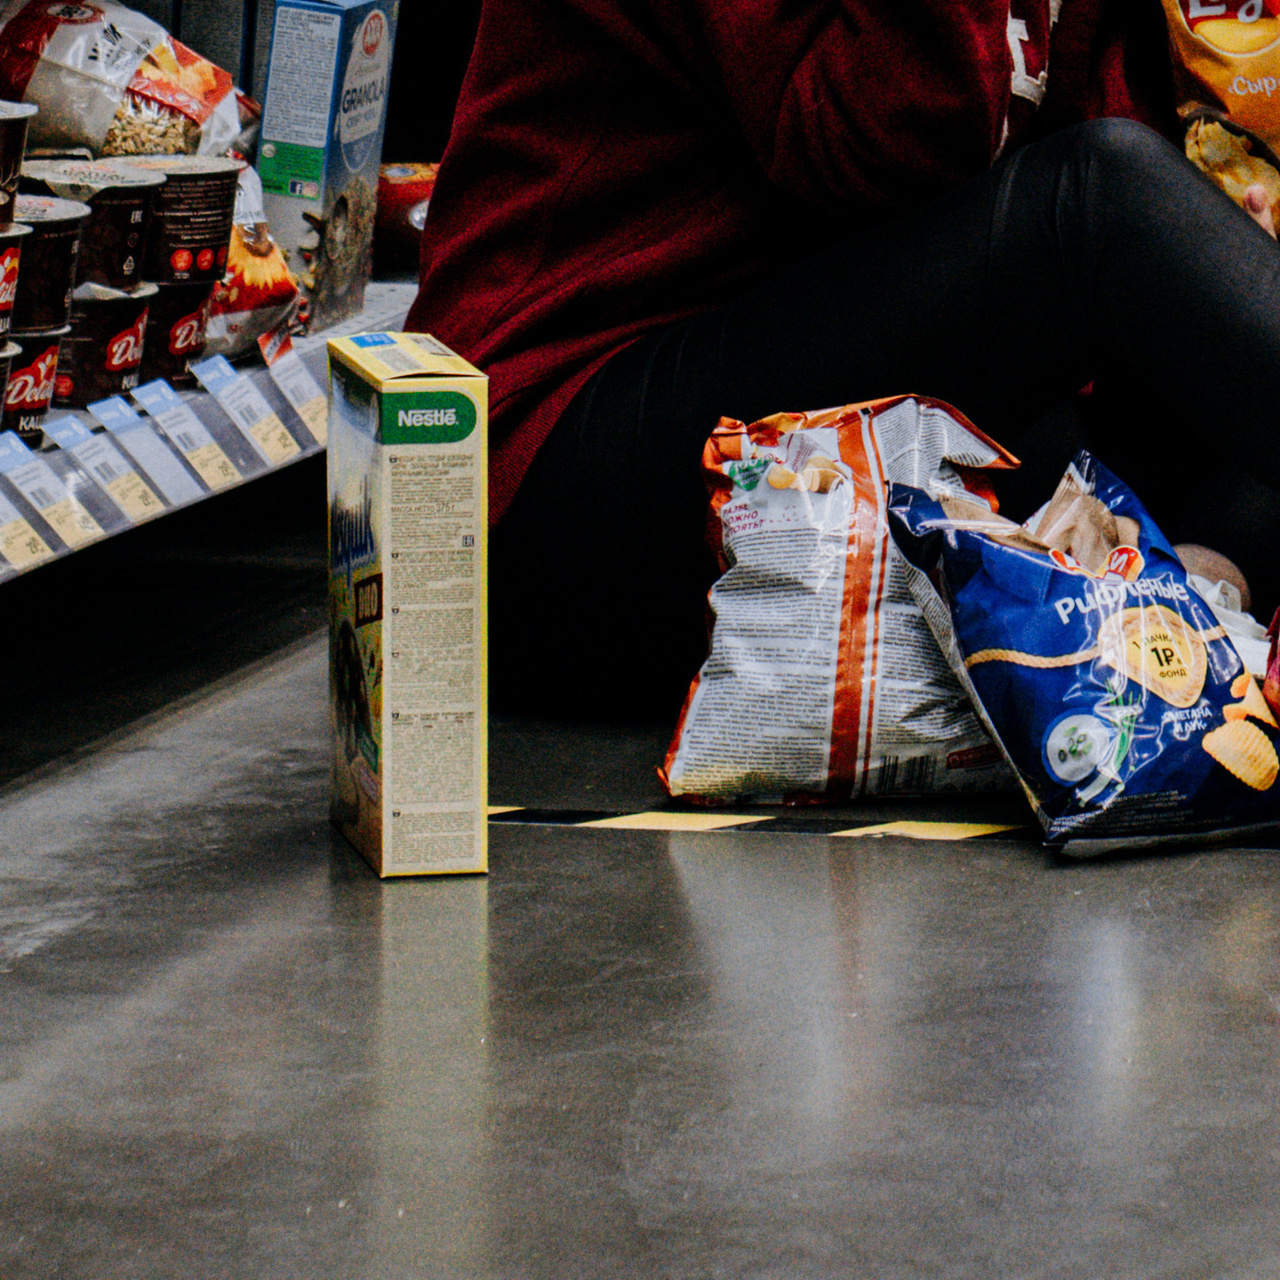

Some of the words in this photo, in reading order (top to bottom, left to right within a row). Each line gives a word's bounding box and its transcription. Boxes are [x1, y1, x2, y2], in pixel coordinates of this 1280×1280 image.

[342, 77, 385, 114] GRANOLA
[727, 510, 759, 525] ОЖНО
[1054, 577, 1190, 626] Рифленые
[1159, 669, 1188, 679] ФОНД
